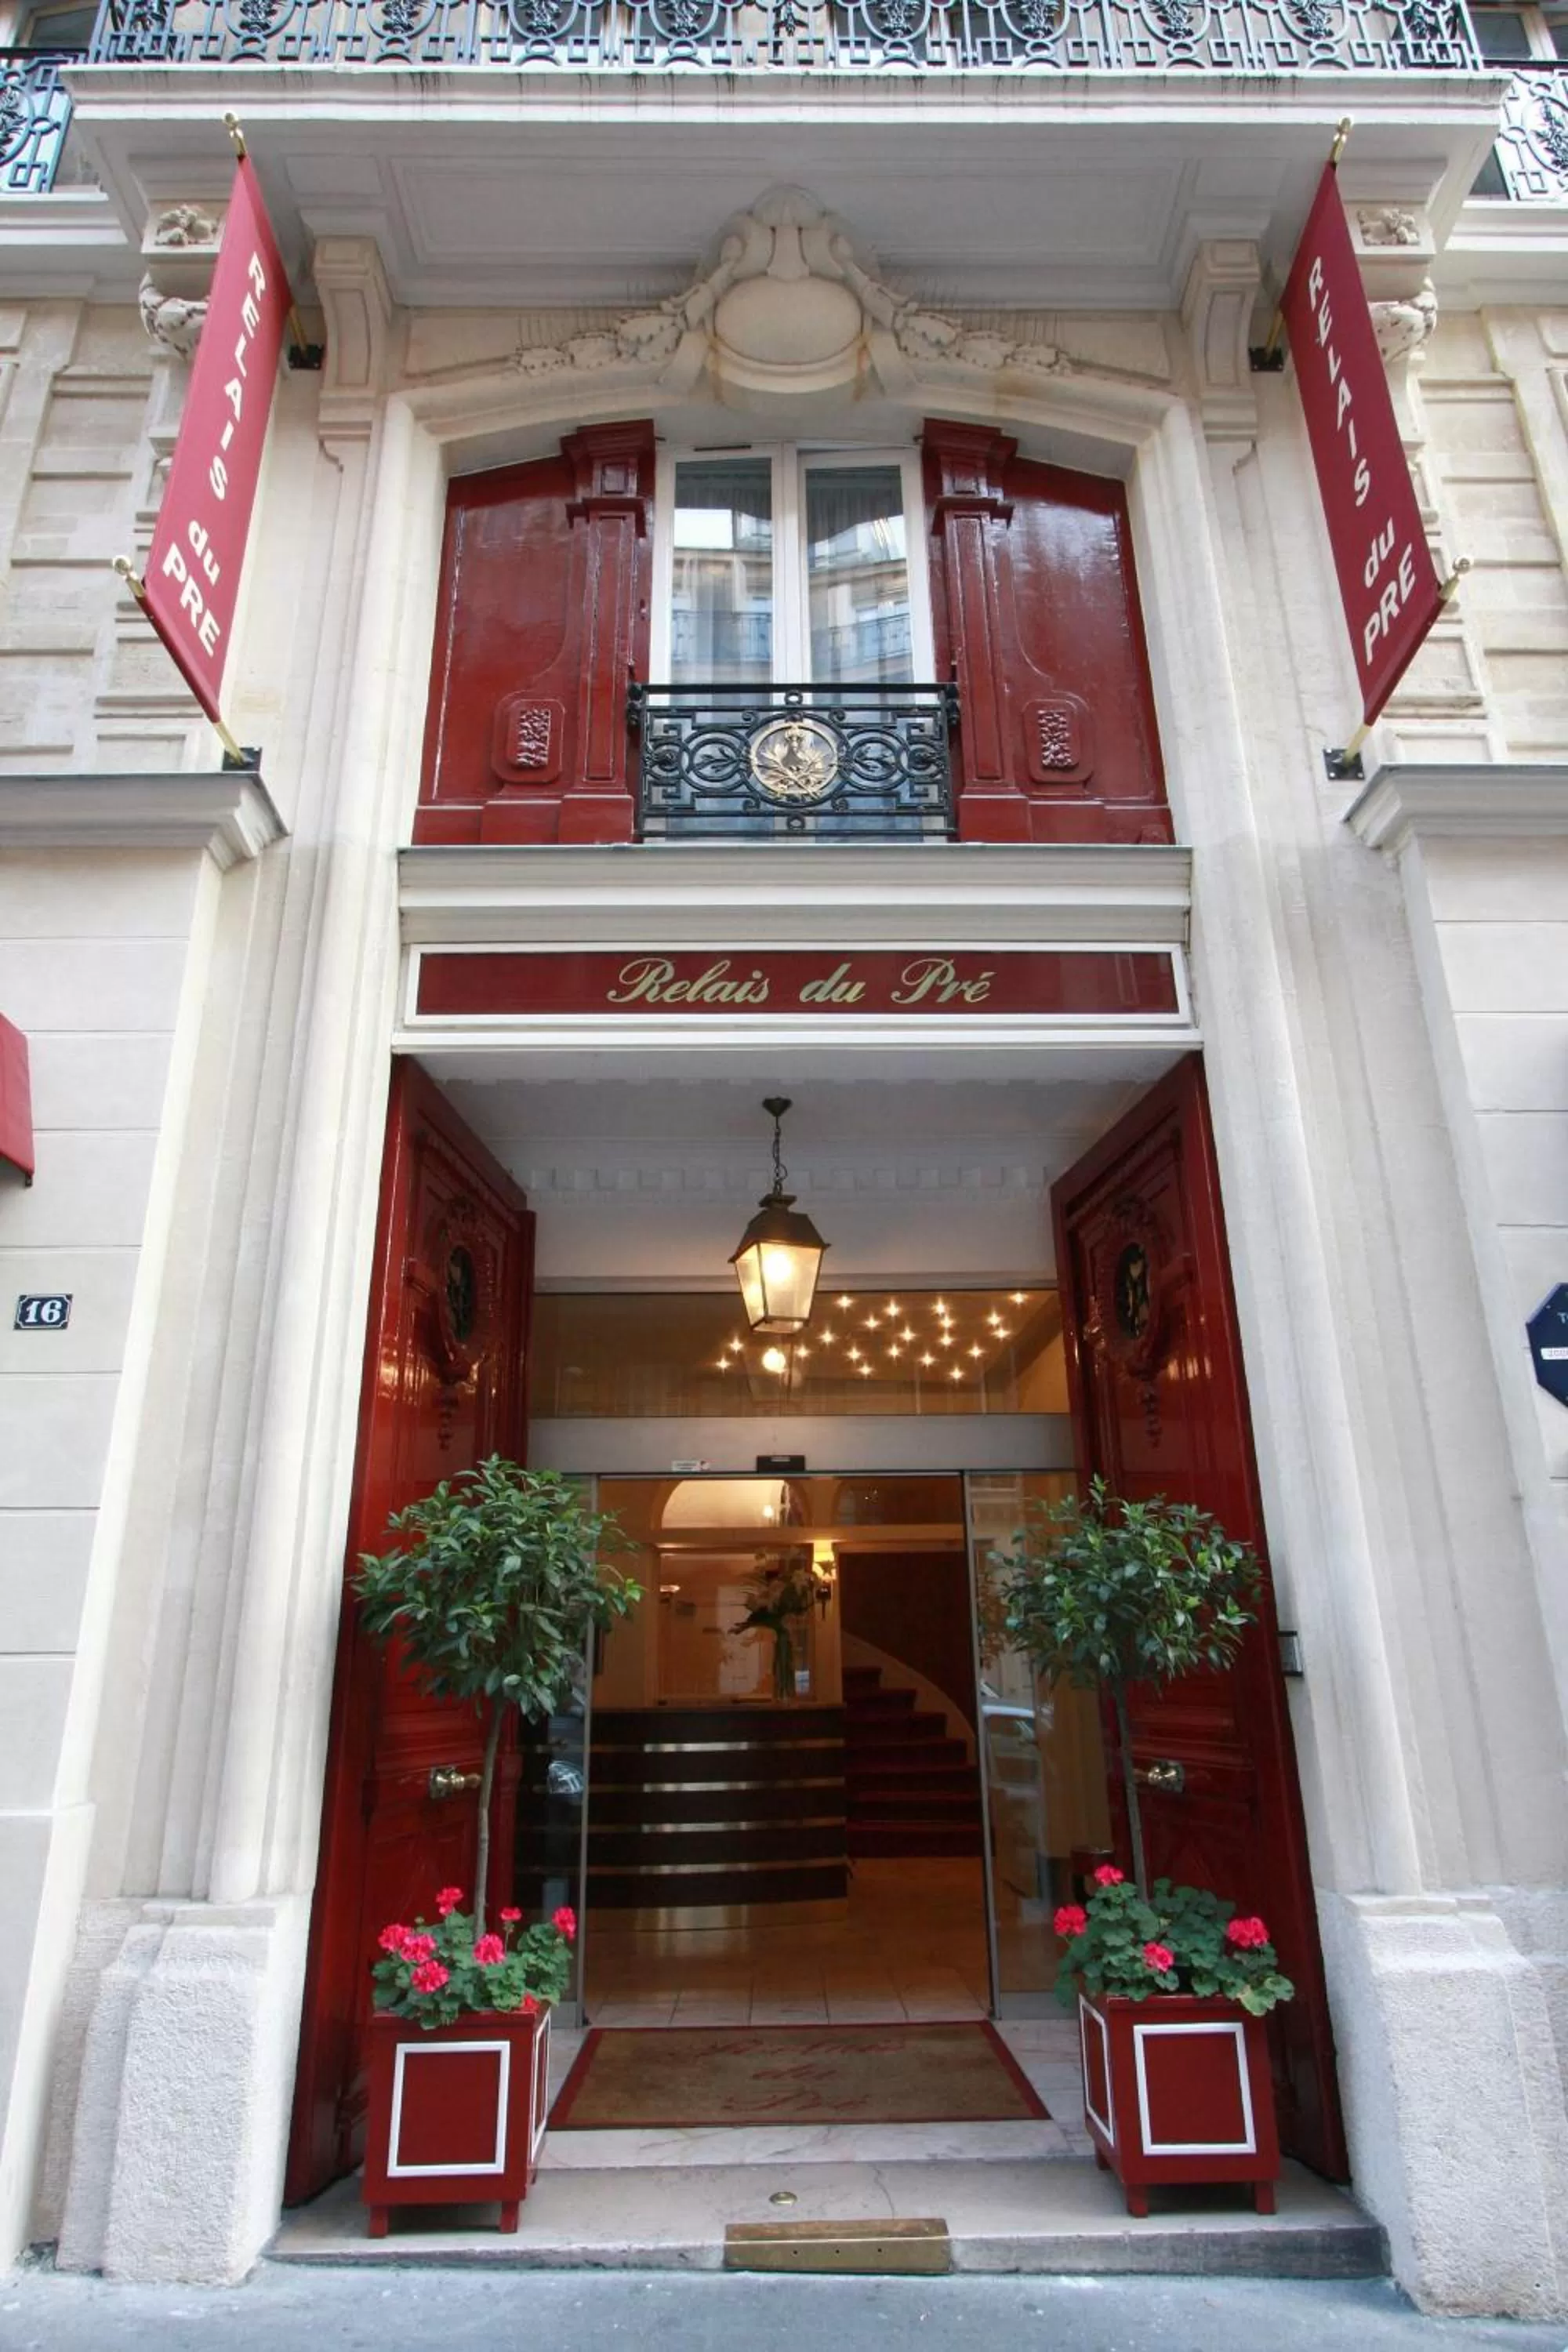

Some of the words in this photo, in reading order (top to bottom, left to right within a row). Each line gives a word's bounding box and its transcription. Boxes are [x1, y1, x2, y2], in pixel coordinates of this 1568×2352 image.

[209, 252, 267, 501] RELAIS
[1308, 256, 1370, 506] RELAIS
[187, 520, 220, 586] du
[1364, 517, 1395, 588] du
[162, 542, 220, 658] PRE
[1364, 542, 1416, 666] PRE
[607, 957, 770, 1004] Relais
[799, 963, 866, 1004] du
[891, 957, 996, 1004] Pré
[25, 1300, 62, 1323] 16
